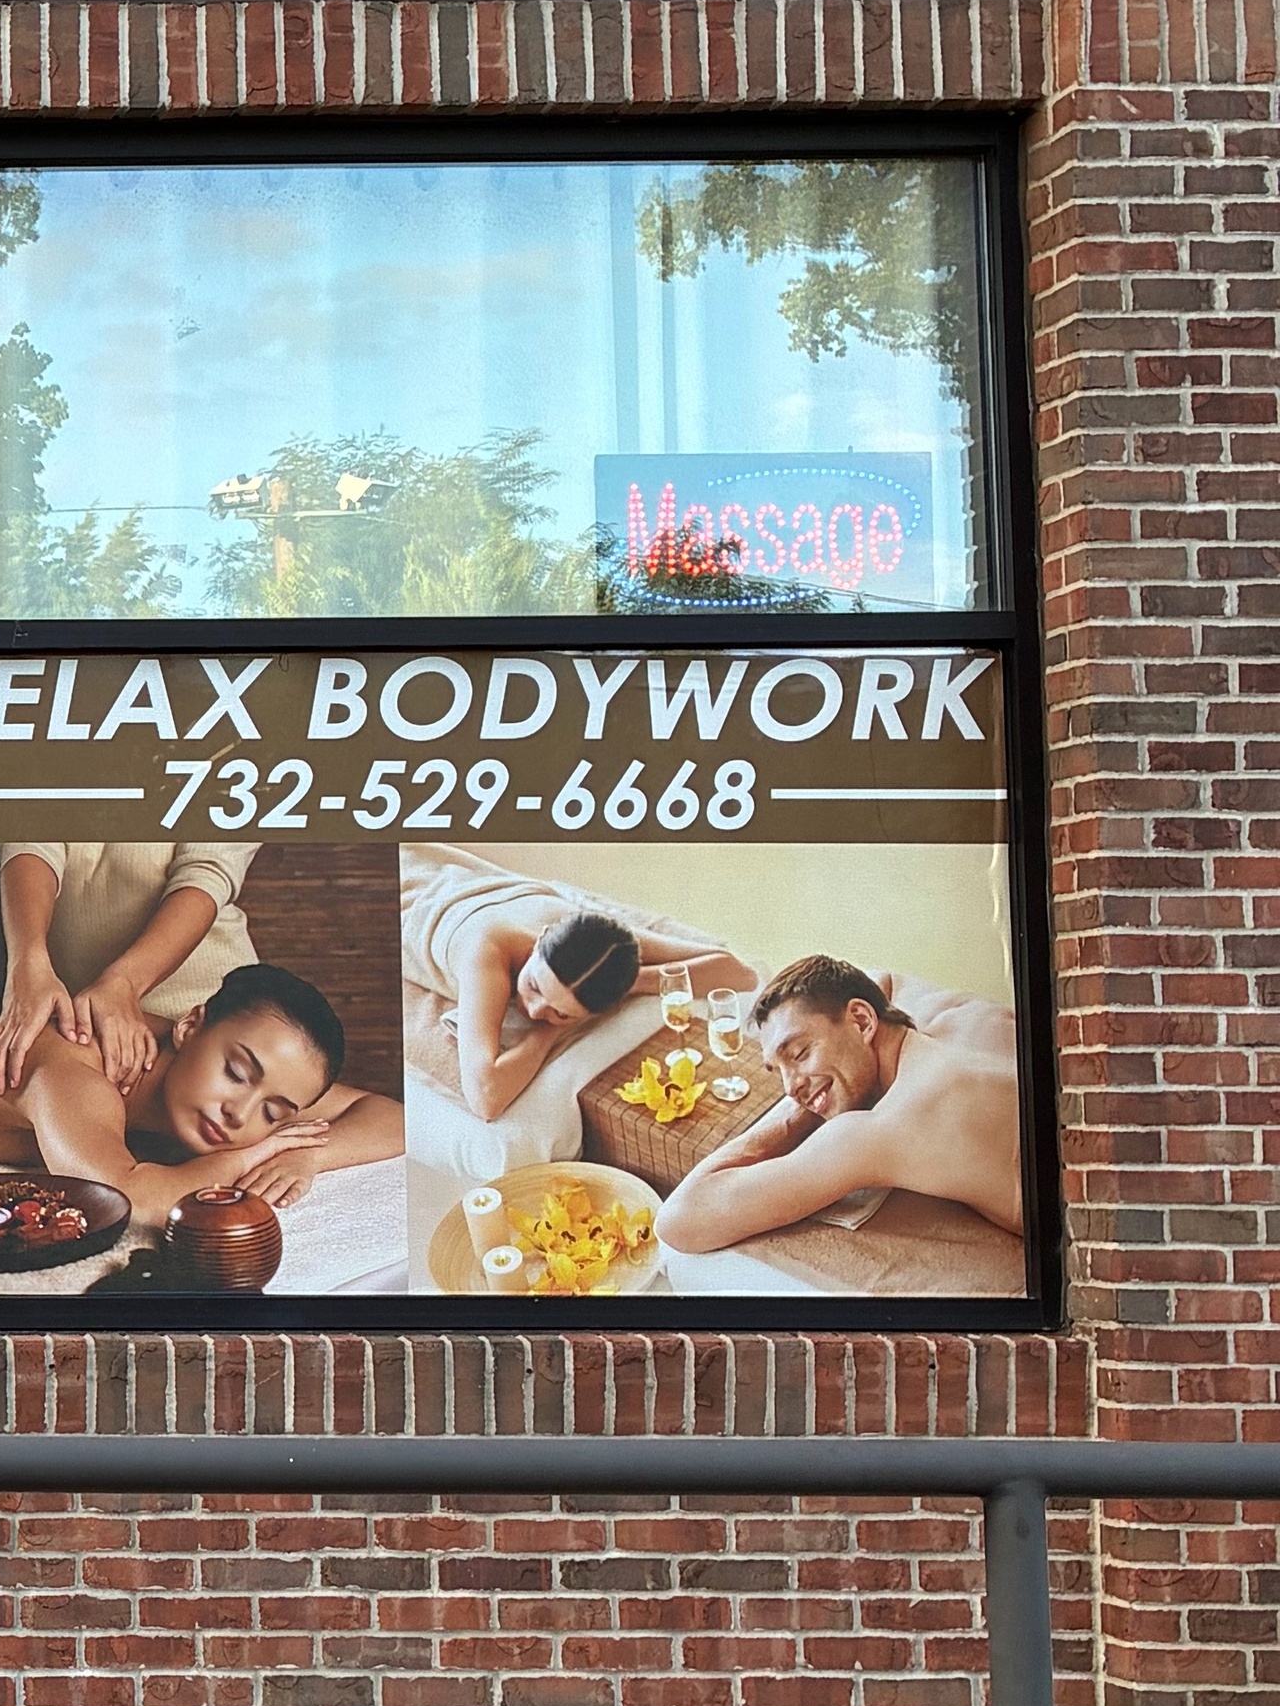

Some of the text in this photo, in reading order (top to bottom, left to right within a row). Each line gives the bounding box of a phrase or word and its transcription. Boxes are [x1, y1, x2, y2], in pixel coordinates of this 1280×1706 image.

[626, 482, 904, 591] Massage
[307, 656, 995, 742] BODYWORK
[160, 758, 757, 831] 732-529-6668
